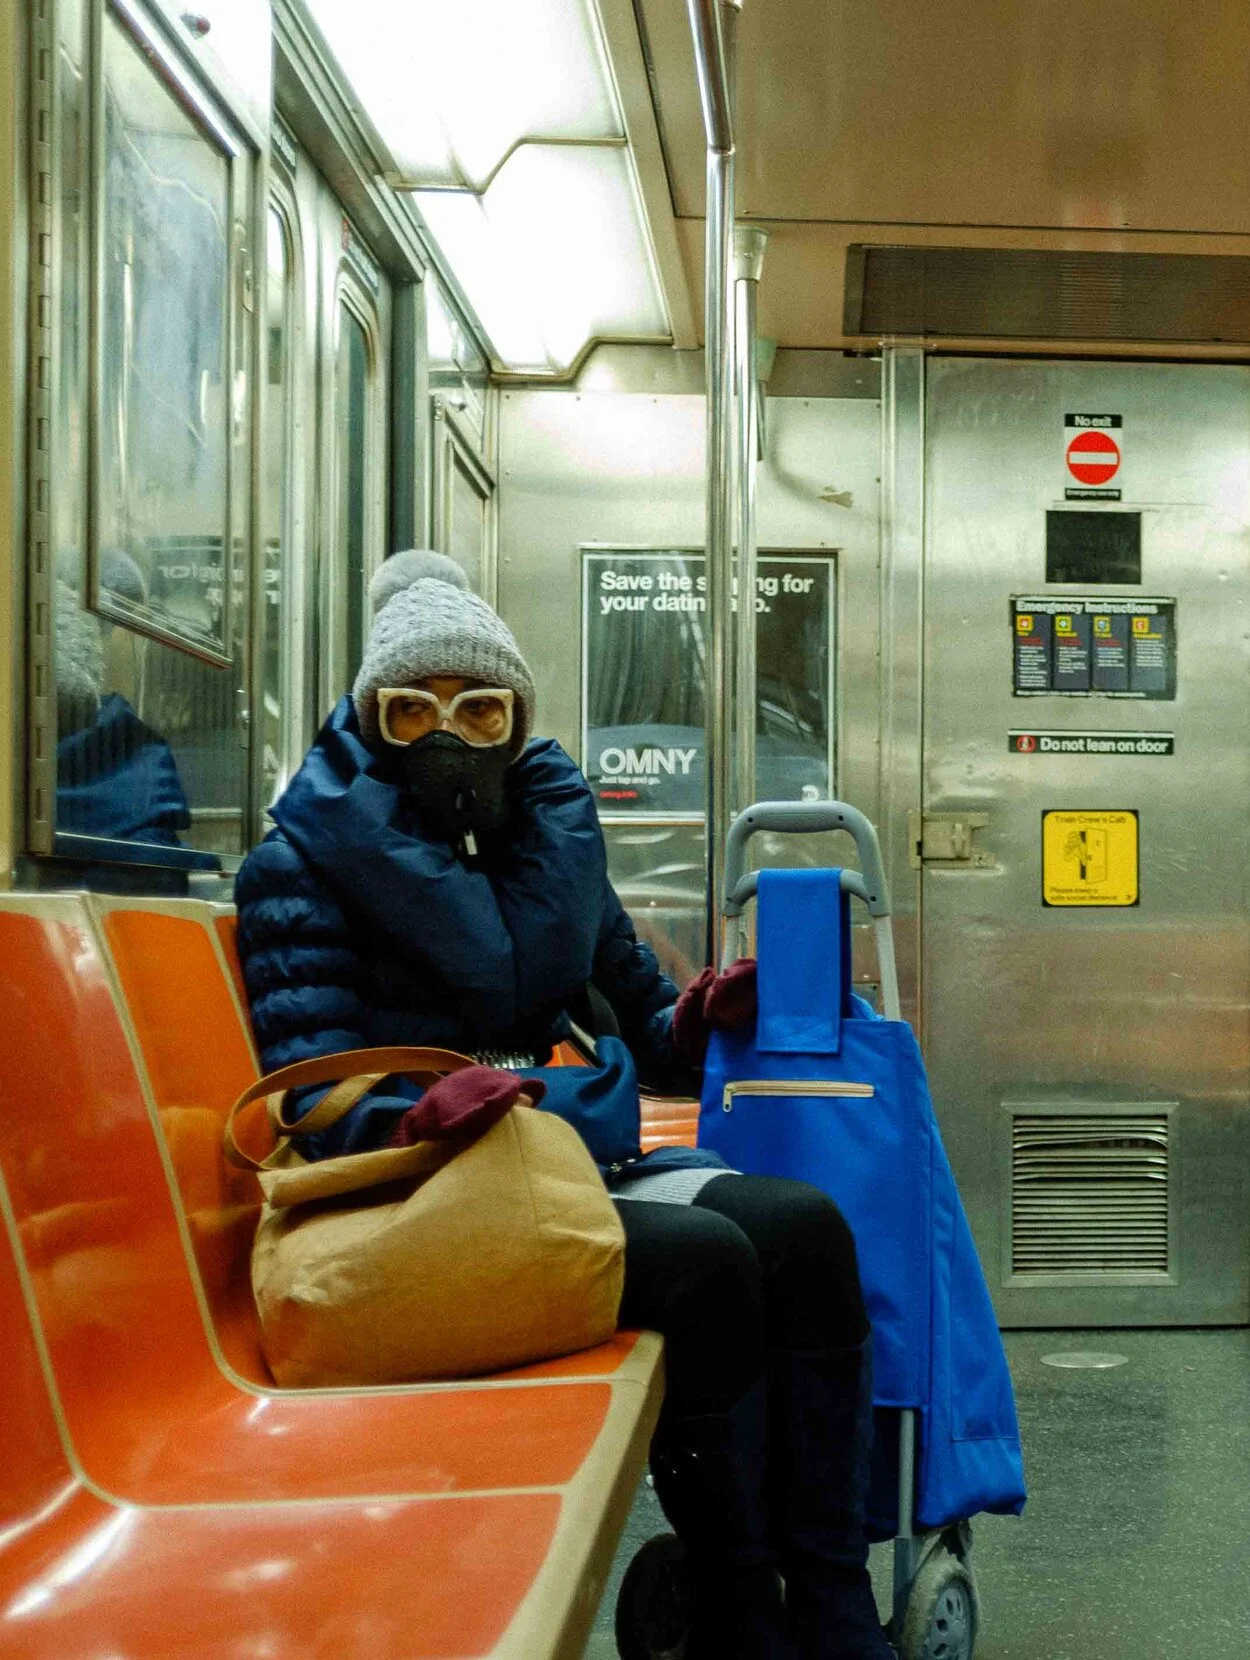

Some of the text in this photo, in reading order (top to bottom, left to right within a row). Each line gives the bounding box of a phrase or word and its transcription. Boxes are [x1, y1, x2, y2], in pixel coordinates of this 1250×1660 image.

[1074, 415, 1112, 427] No exit
[600, 570, 652, 591] Save
[656, 571, 692, 591] the
[782, 573, 814, 593] for
[600, 594, 648, 614] your
[652, 591, 706, 611] datin
[1016, 601, 1158, 614] Emergency Instructions
[1040, 737, 1168, 753] Do not lean on door
[599, 747, 697, 775] OMNY
